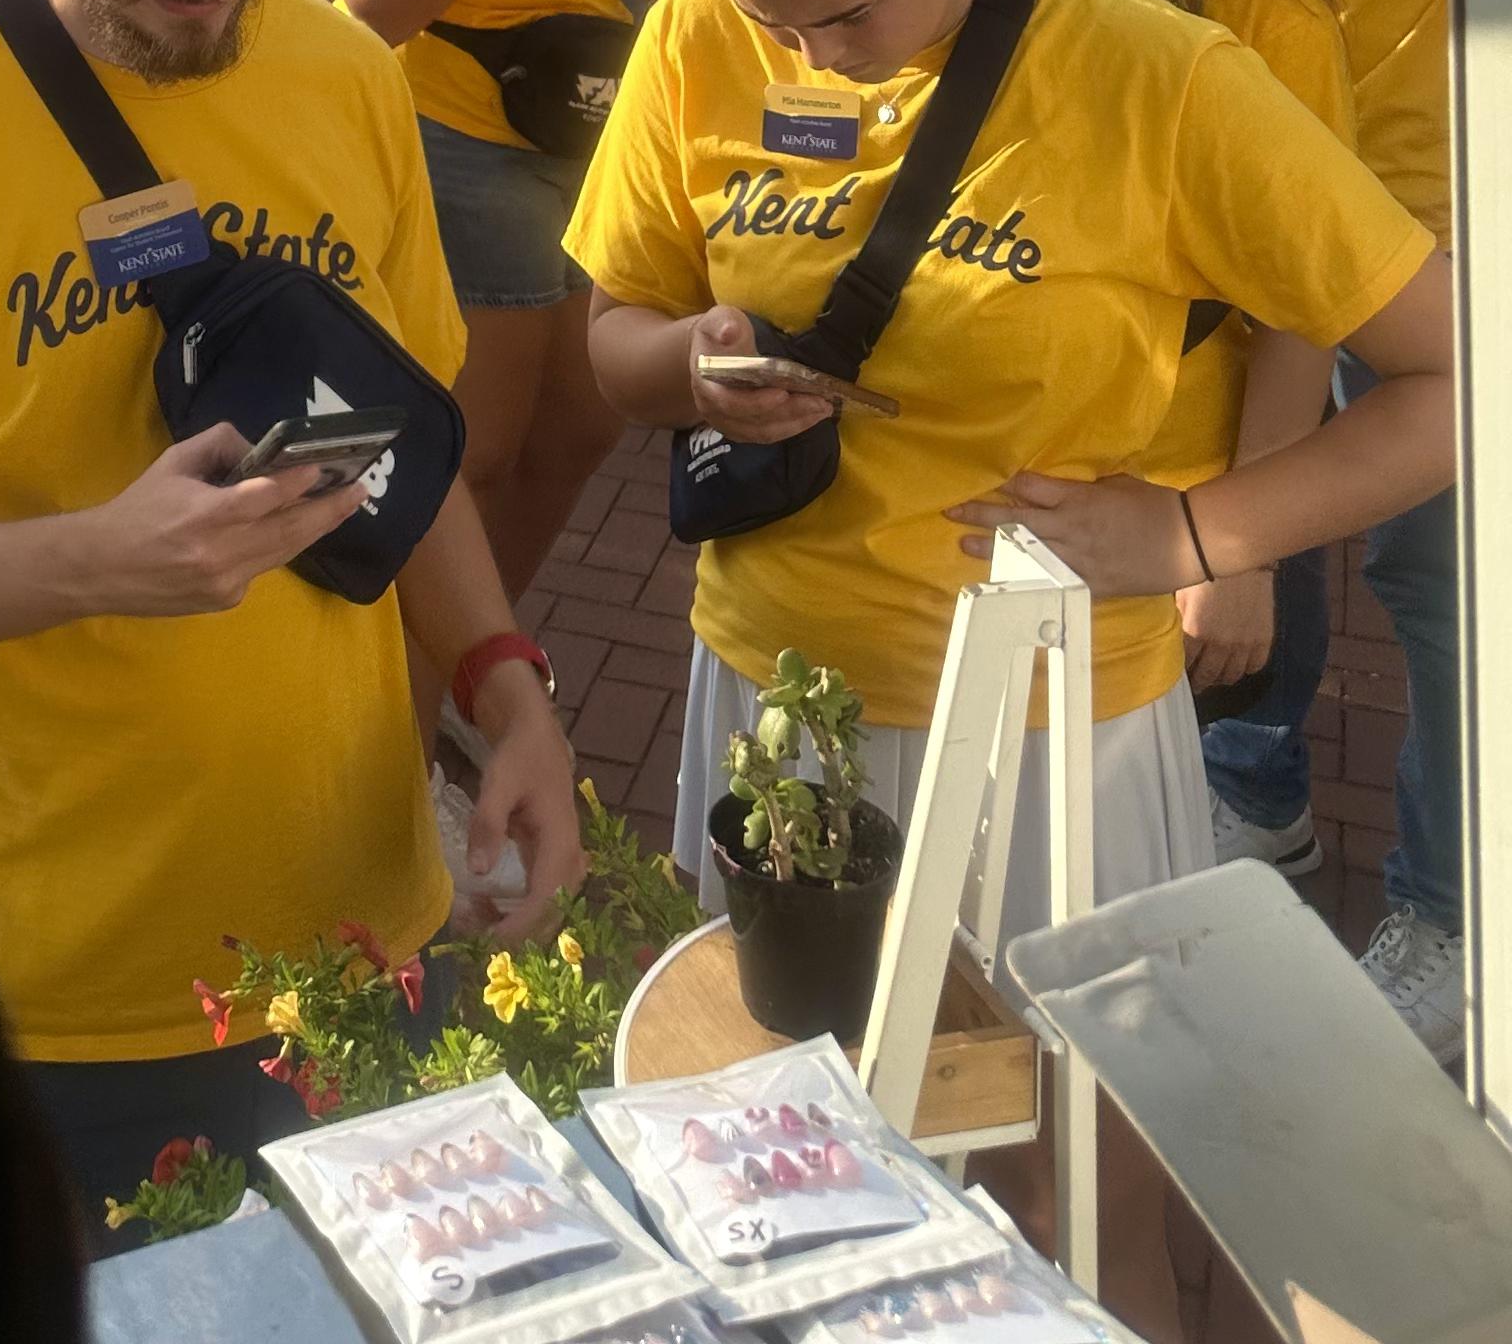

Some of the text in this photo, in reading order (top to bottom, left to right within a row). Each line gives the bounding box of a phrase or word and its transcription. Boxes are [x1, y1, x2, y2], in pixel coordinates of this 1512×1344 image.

[781, 134, 837, 150] KENT STATE
[108, 207, 139, 224] Cooper
[706, 168, 861, 239] Kent
[117, 252, 150, 273] KENT
[150, 241, 186, 262] STATE
[431, 1265, 464, 1291] S
